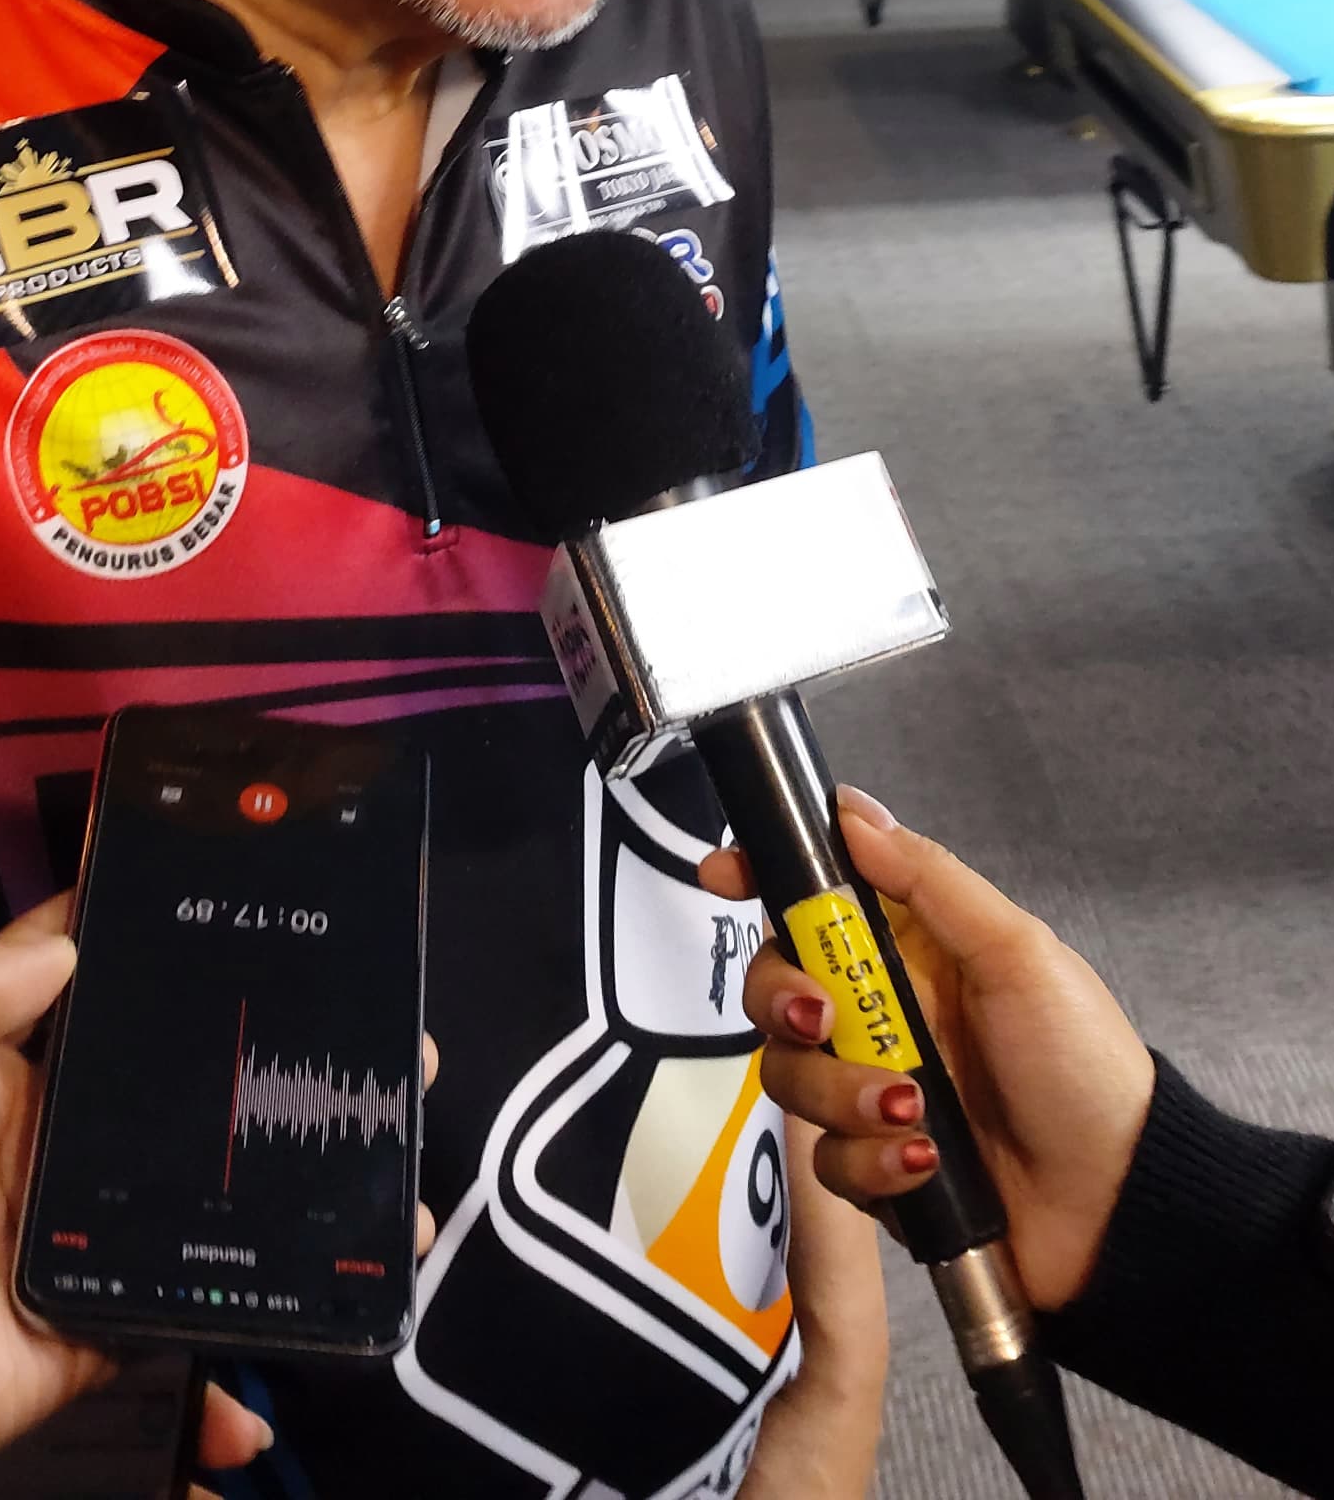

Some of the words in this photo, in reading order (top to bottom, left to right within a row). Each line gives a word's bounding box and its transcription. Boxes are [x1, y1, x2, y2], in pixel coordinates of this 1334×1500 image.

[51, 526, 175, 572] PENGURUS
[181, 480, 238, 553] BESAR
[79, 471, 207, 532] POBSI
[176, 896, 328, 937] 00:17.89
[181, 1242, 256, 1267] Standard
